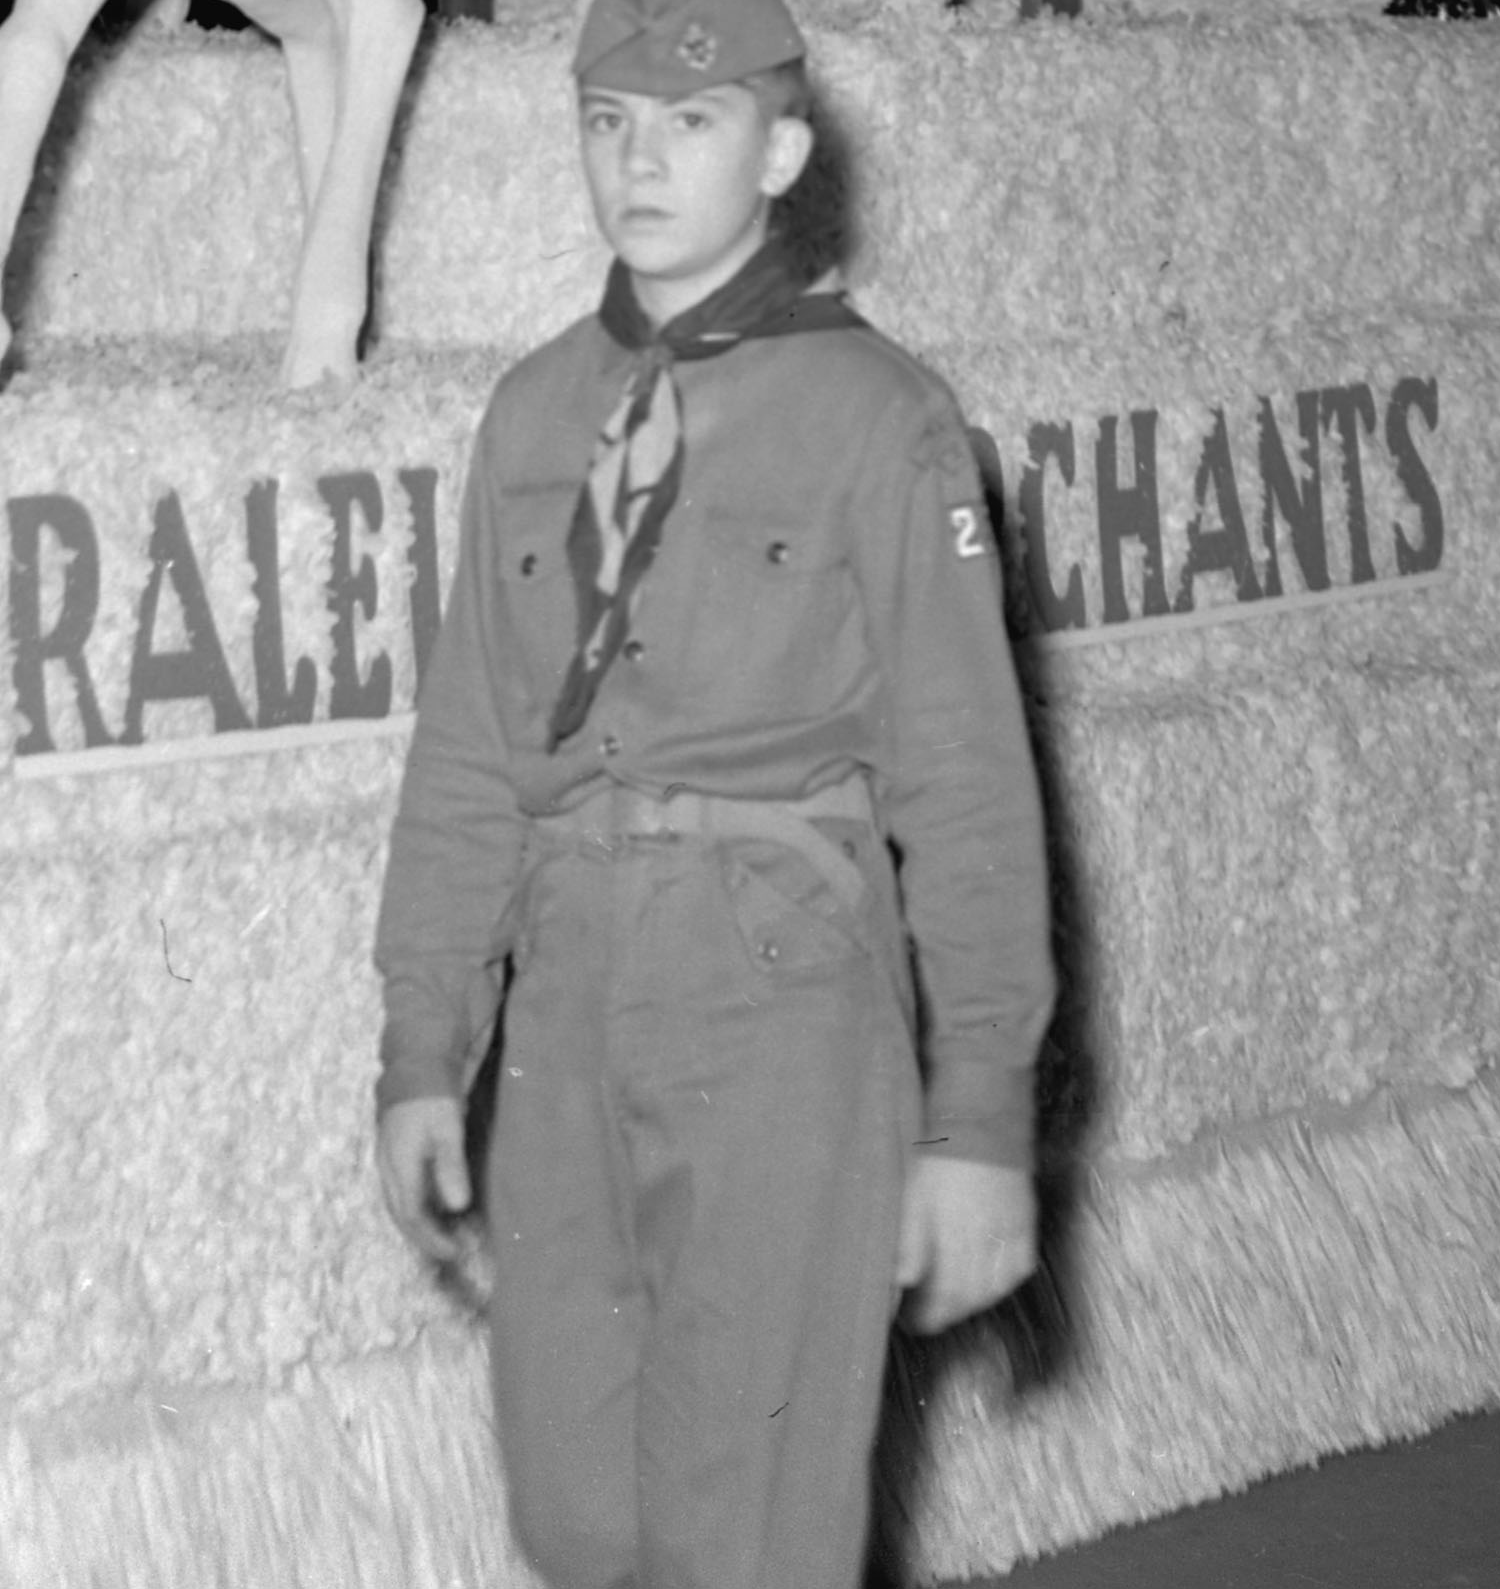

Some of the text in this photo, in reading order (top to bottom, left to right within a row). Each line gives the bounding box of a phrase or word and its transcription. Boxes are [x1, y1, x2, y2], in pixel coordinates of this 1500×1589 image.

[6, 467, 442, 755] RALEI
[966, 377, 1443, 632] CHANTS
[951, 507, 985, 557] 2
